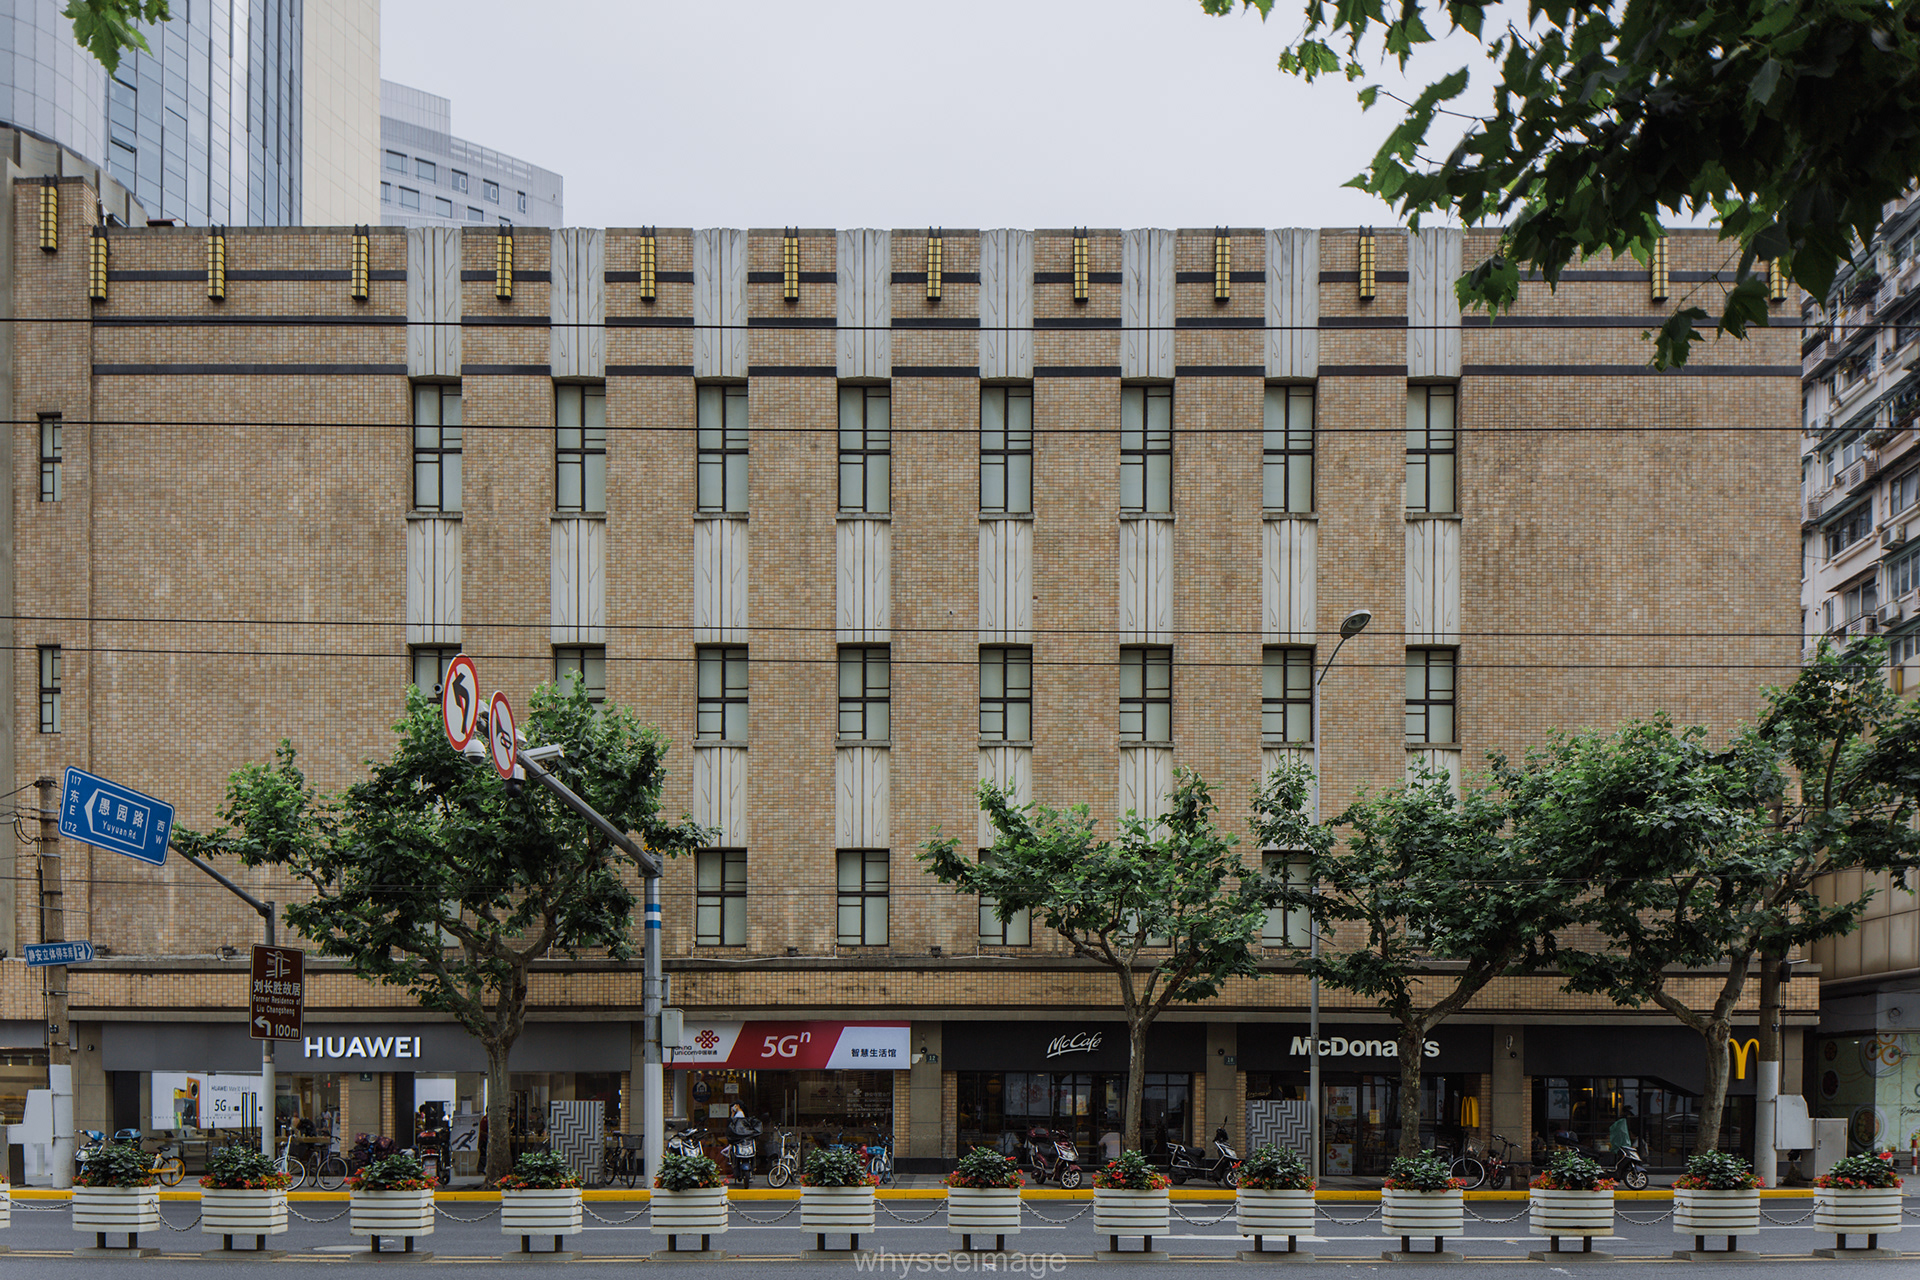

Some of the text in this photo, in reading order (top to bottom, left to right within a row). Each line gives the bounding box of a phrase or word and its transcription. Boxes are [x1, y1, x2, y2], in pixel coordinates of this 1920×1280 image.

[71, 775, 82, 786] 117
[69, 789, 80, 803] 东
[69, 805, 76, 816] E
[98, 797, 144, 828] 愚园路
[64, 821, 78, 833] 172
[102, 820, 128, 837] Yuyuan
[156, 819, 166, 833] 西
[155, 834, 163, 845] W
[253, 978, 302, 997] 刘长胜故居
[252, 994, 271, 1003] Former
[270, 995, 295, 1006] Residence
[256, 1004, 296, 1018] Liu Changsheng
[274, 1023, 300, 1038] 100m
[303, 1036, 422, 1059] HUAWEI
[850, 1047, 897, 1059] 智慧生活馆
[1289, 1036, 1441, 1058] McDona's
[214, 1098, 227, 1112] 5G
